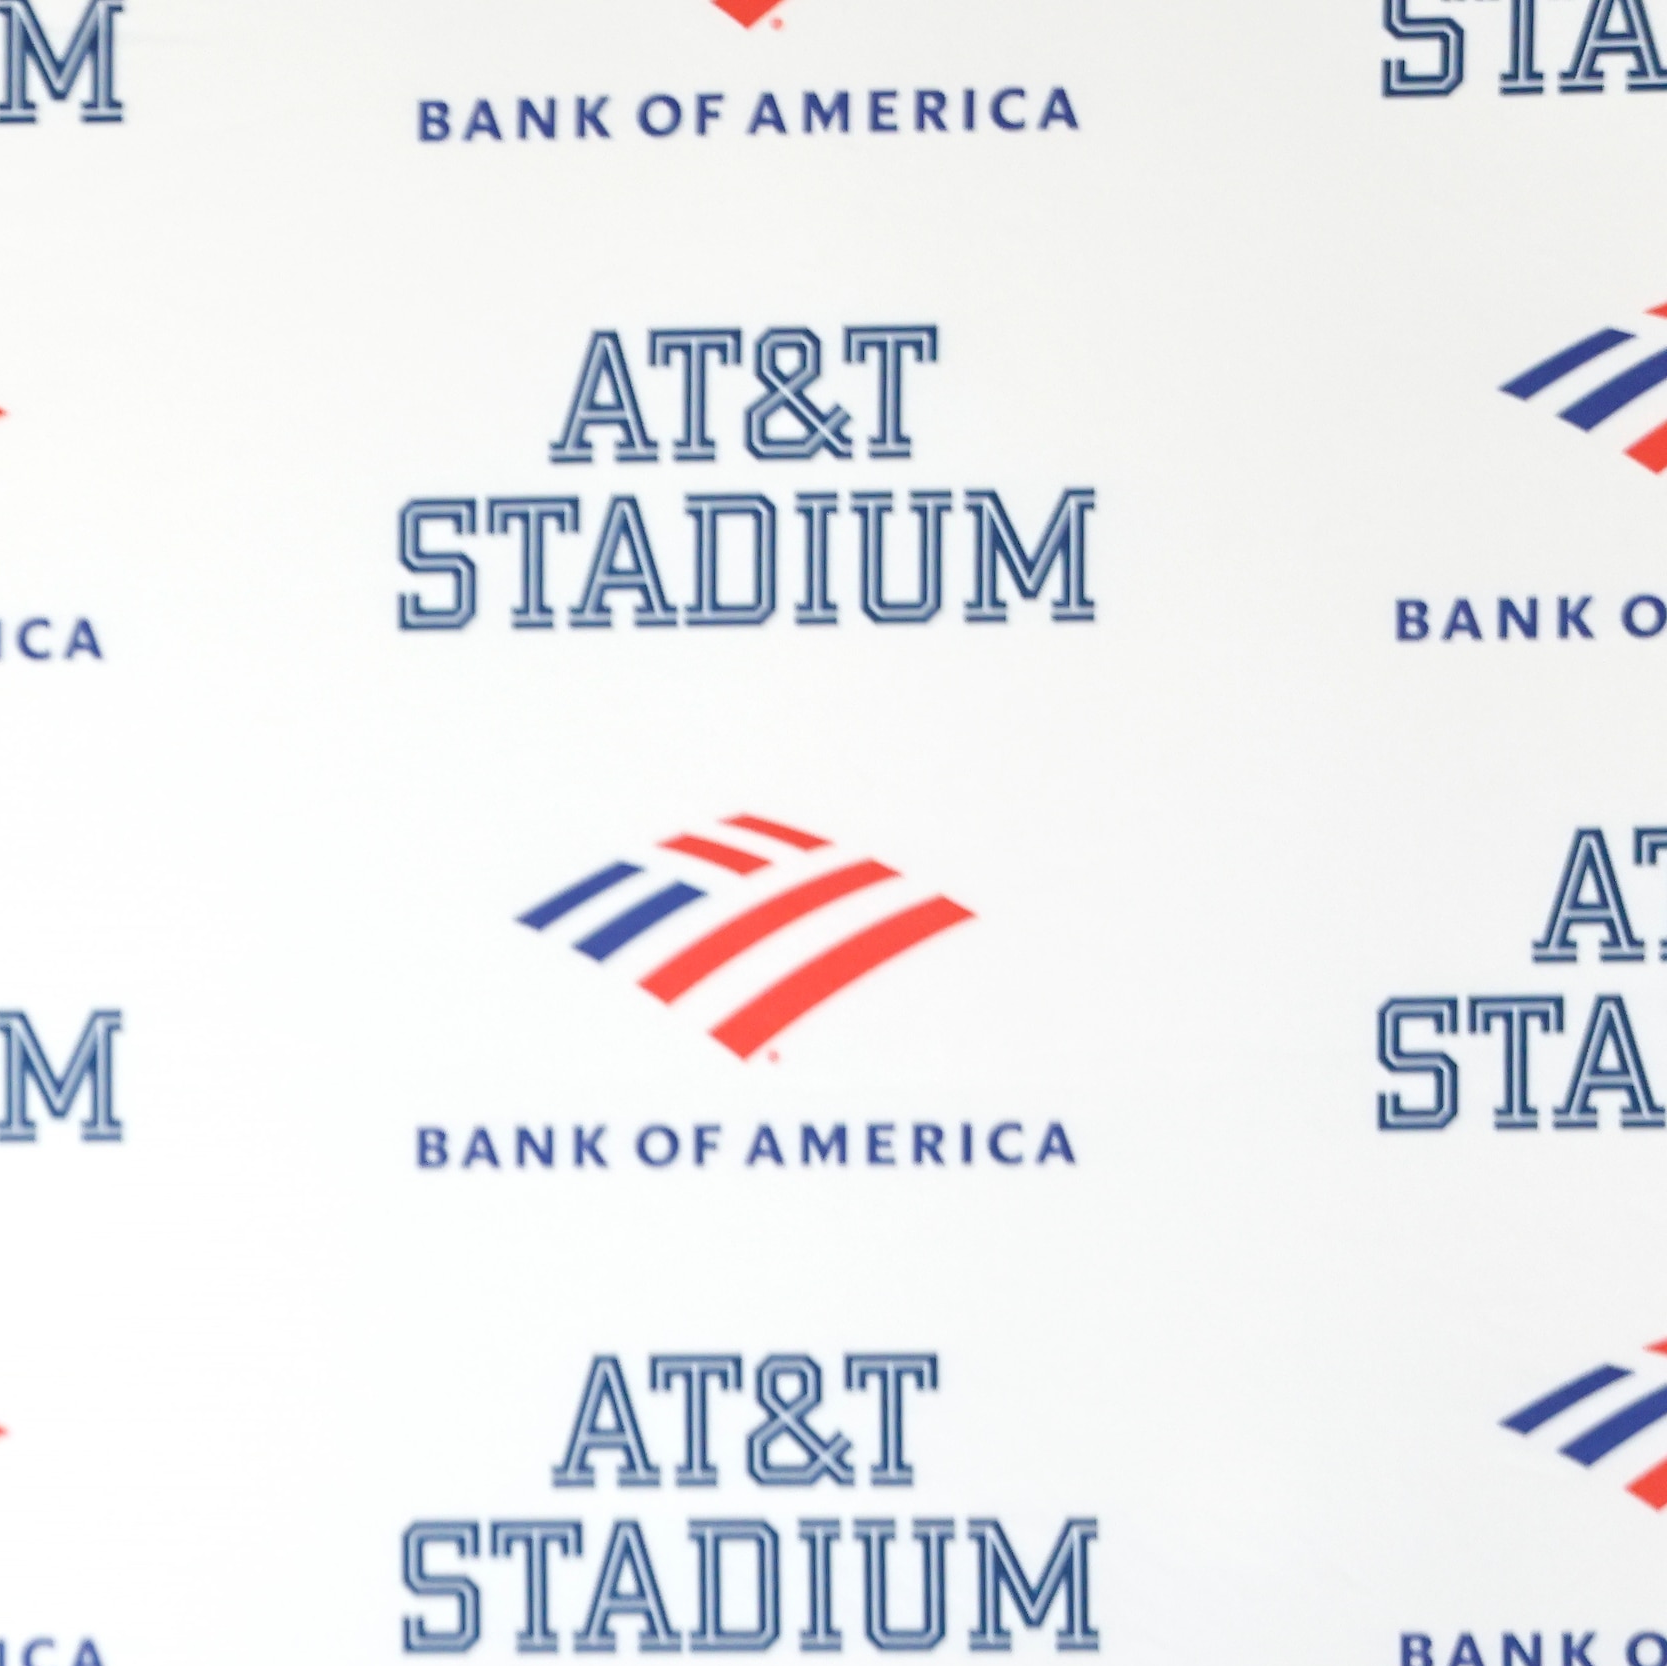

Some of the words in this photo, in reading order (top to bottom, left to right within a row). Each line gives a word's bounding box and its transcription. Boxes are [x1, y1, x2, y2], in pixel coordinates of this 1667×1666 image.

[419, 96, 610, 142] BANK
[637, 93, 724, 137] OF
[748, 87, 1078, 134] AMERICA
[550, 324, 938, 464] AT&T
[399, 488, 1095, 631] STADIUM
[1396, 596, 1593, 641] BANK
[1533, 827, 1667, 963] A
[417, 1126, 607, 1168] BANK
[636, 1125, 720, 1167] OF
[747, 1122, 1075, 1165] AMERICA
[553, 1353, 938, 1487] AT&T
[402, 1518, 1099, 1653] STADIUM
